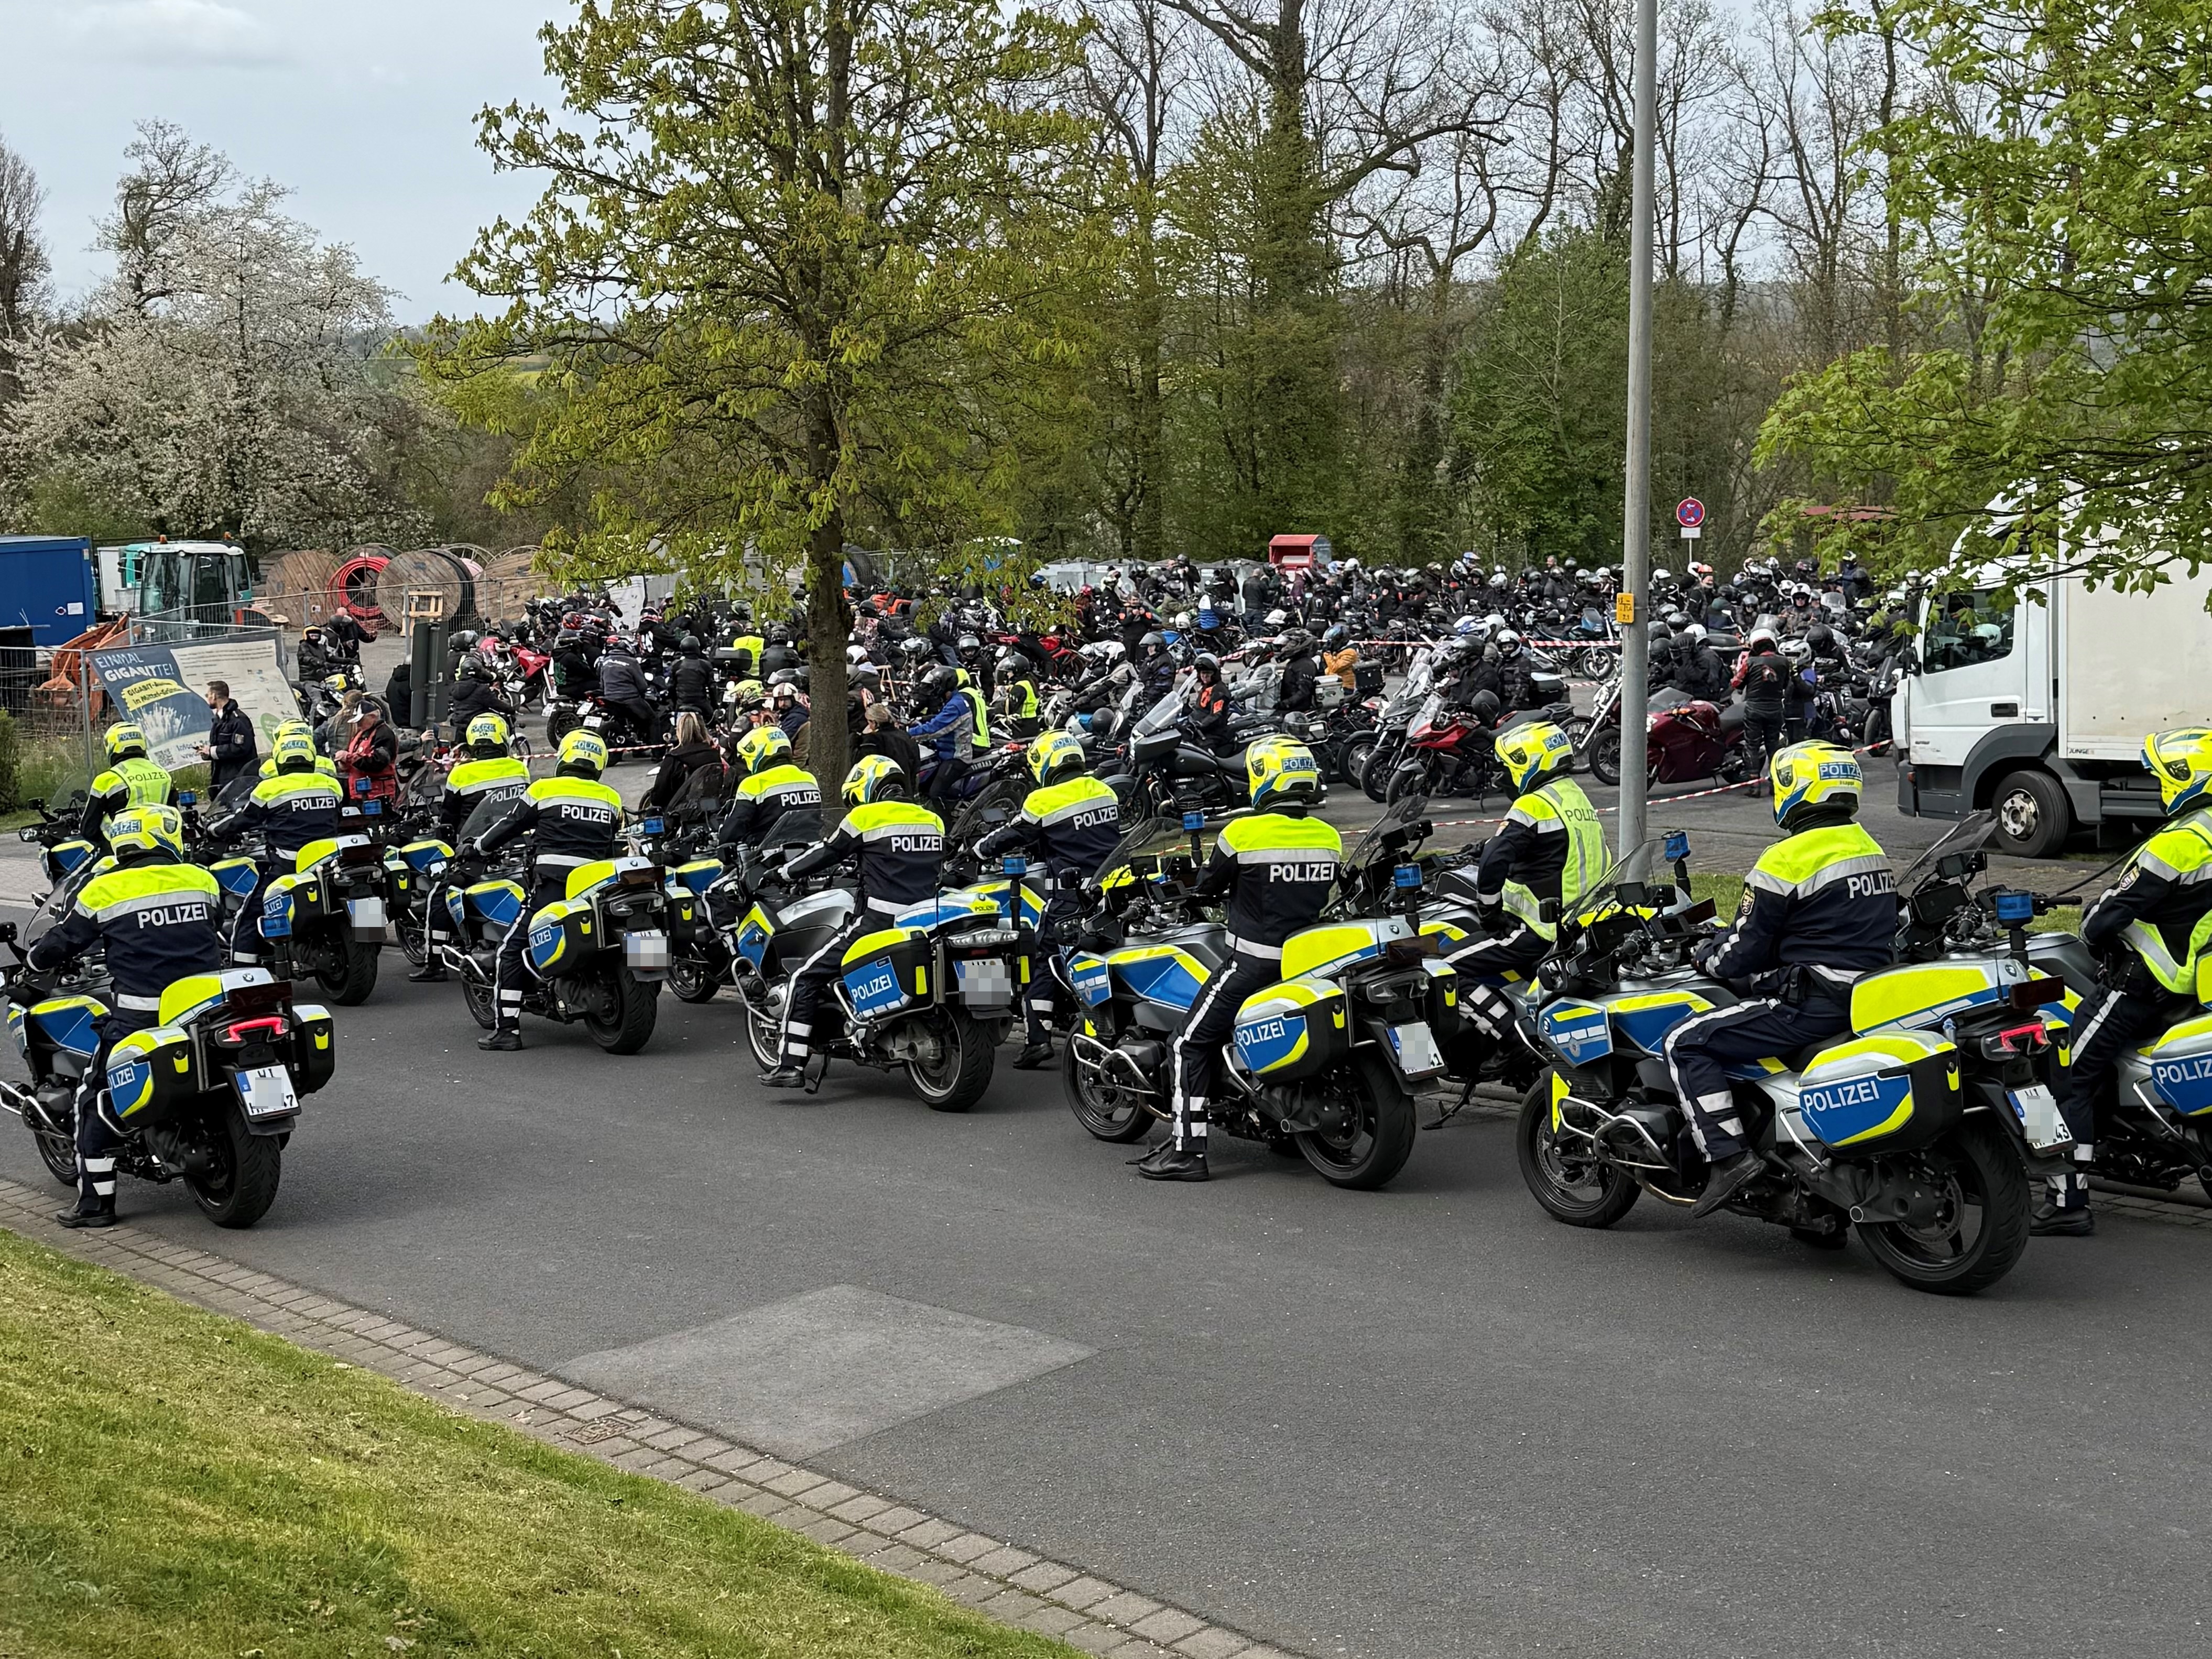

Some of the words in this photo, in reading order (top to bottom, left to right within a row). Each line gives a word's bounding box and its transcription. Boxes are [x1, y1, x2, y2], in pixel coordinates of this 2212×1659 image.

[95, 652, 144, 668] EINMAL
[127, 771, 169, 783] POLIZEI
[291, 797, 335, 812] POLIZEI
[561, 805, 611, 824] POLIZEI
[1073, 805, 1118, 830] POLIZEI
[891, 836, 942, 852] POLIZEI
[1269, 863, 1334, 882] POLIZEI
[1847, 872, 1895, 899] POLIZE
[137, 903, 208, 929] POLIZEI
[851, 974, 892, 1003] POLIZEI
[1237, 1020, 1285, 1045] POLIZEI
[1803, 1080, 1879, 1114] POLIZEI
